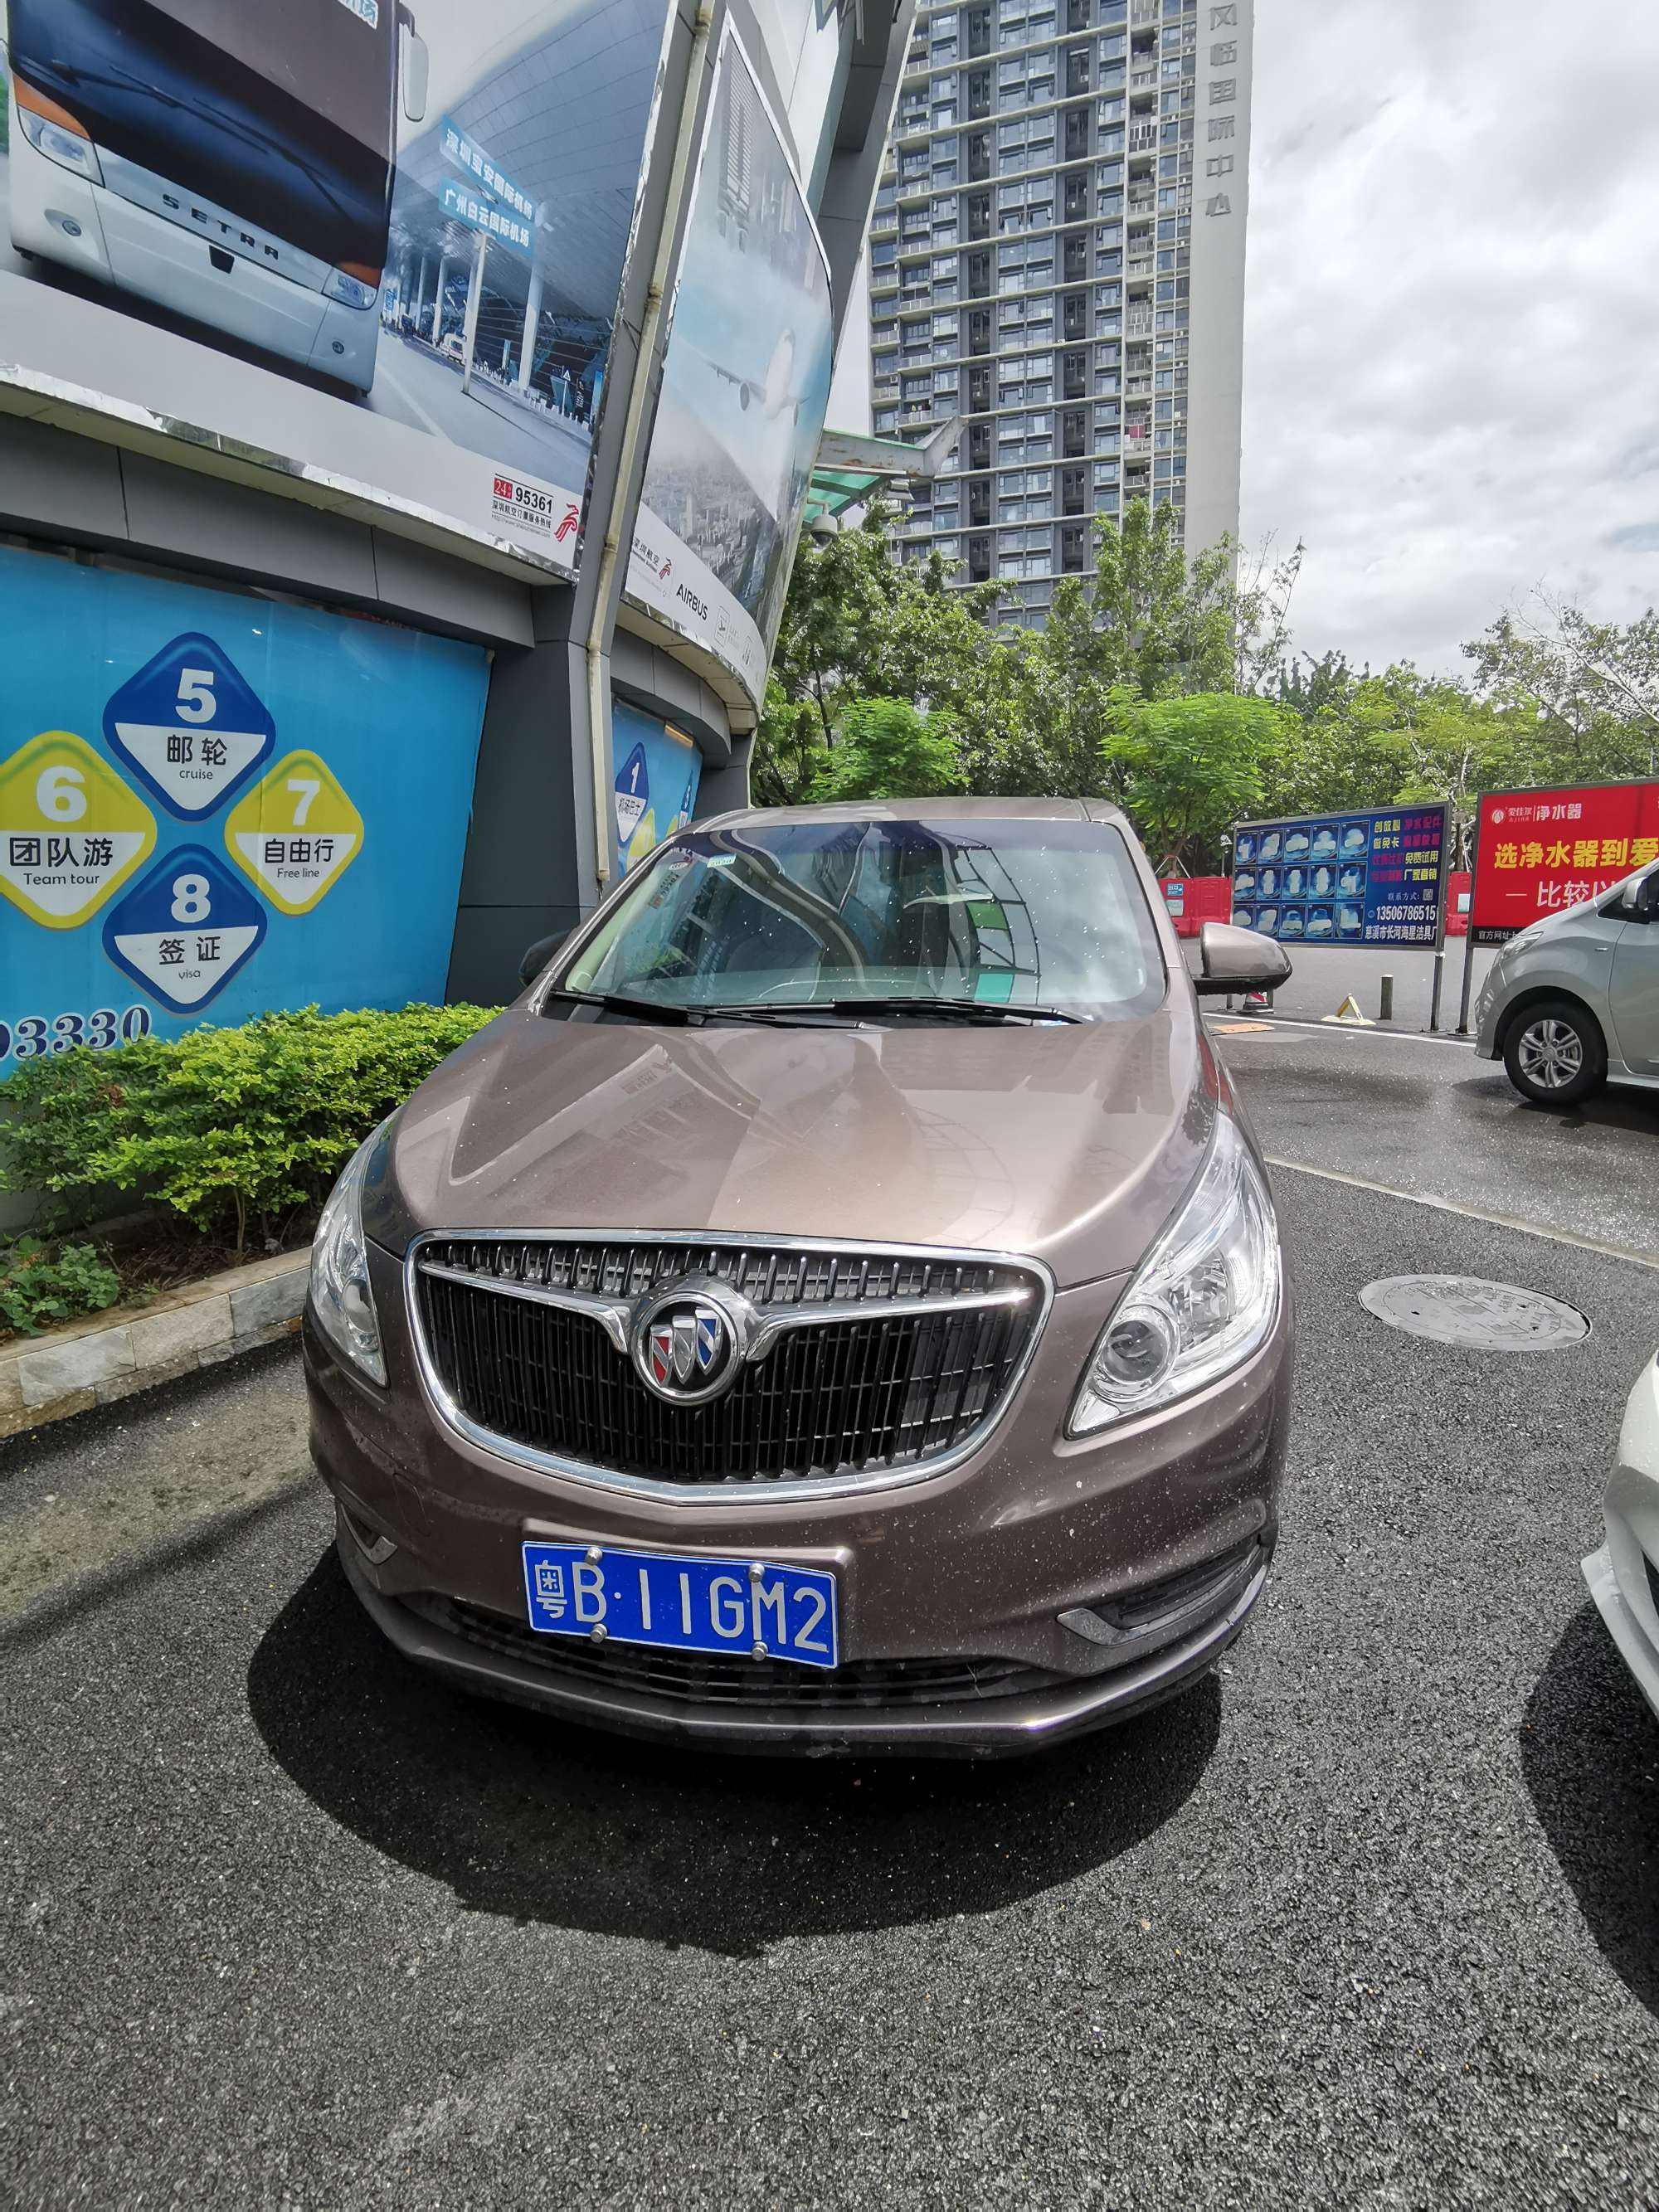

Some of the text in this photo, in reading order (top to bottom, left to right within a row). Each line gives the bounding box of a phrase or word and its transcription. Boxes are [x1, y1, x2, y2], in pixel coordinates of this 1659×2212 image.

[163, 193, 279, 260] SETRA
[444, 187, 530, 247] 广州白云国际机场
[515, 487, 553, 513] 95361
[676, 583, 709, 620] AIRBUS
[174, 667, 217, 723] 5
[166, 733, 228, 766] 邮轮
[178, 767, 214, 780] cruise
[36, 765, 88, 823] 6
[287, 779, 321, 826] 7
[1536, 802, 1583, 821] 净水器
[9, 836, 114, 868] 团队游
[265, 838, 334, 863] 自由行
[1404, 850, 1439, 865] 免费试用
[1494, 837, 1659, 869] 选净水器到爱
[23, 872, 100, 885] Team tour
[276, 867, 320, 878] Free line
[1404, 868, 1438, 882] 厂家直销
[170, 873, 212, 924] 8
[1376, 905, 1436, 921] 13506786515
[158, 935, 221, 965] 签证
[178, 967, 202, 980] visa
